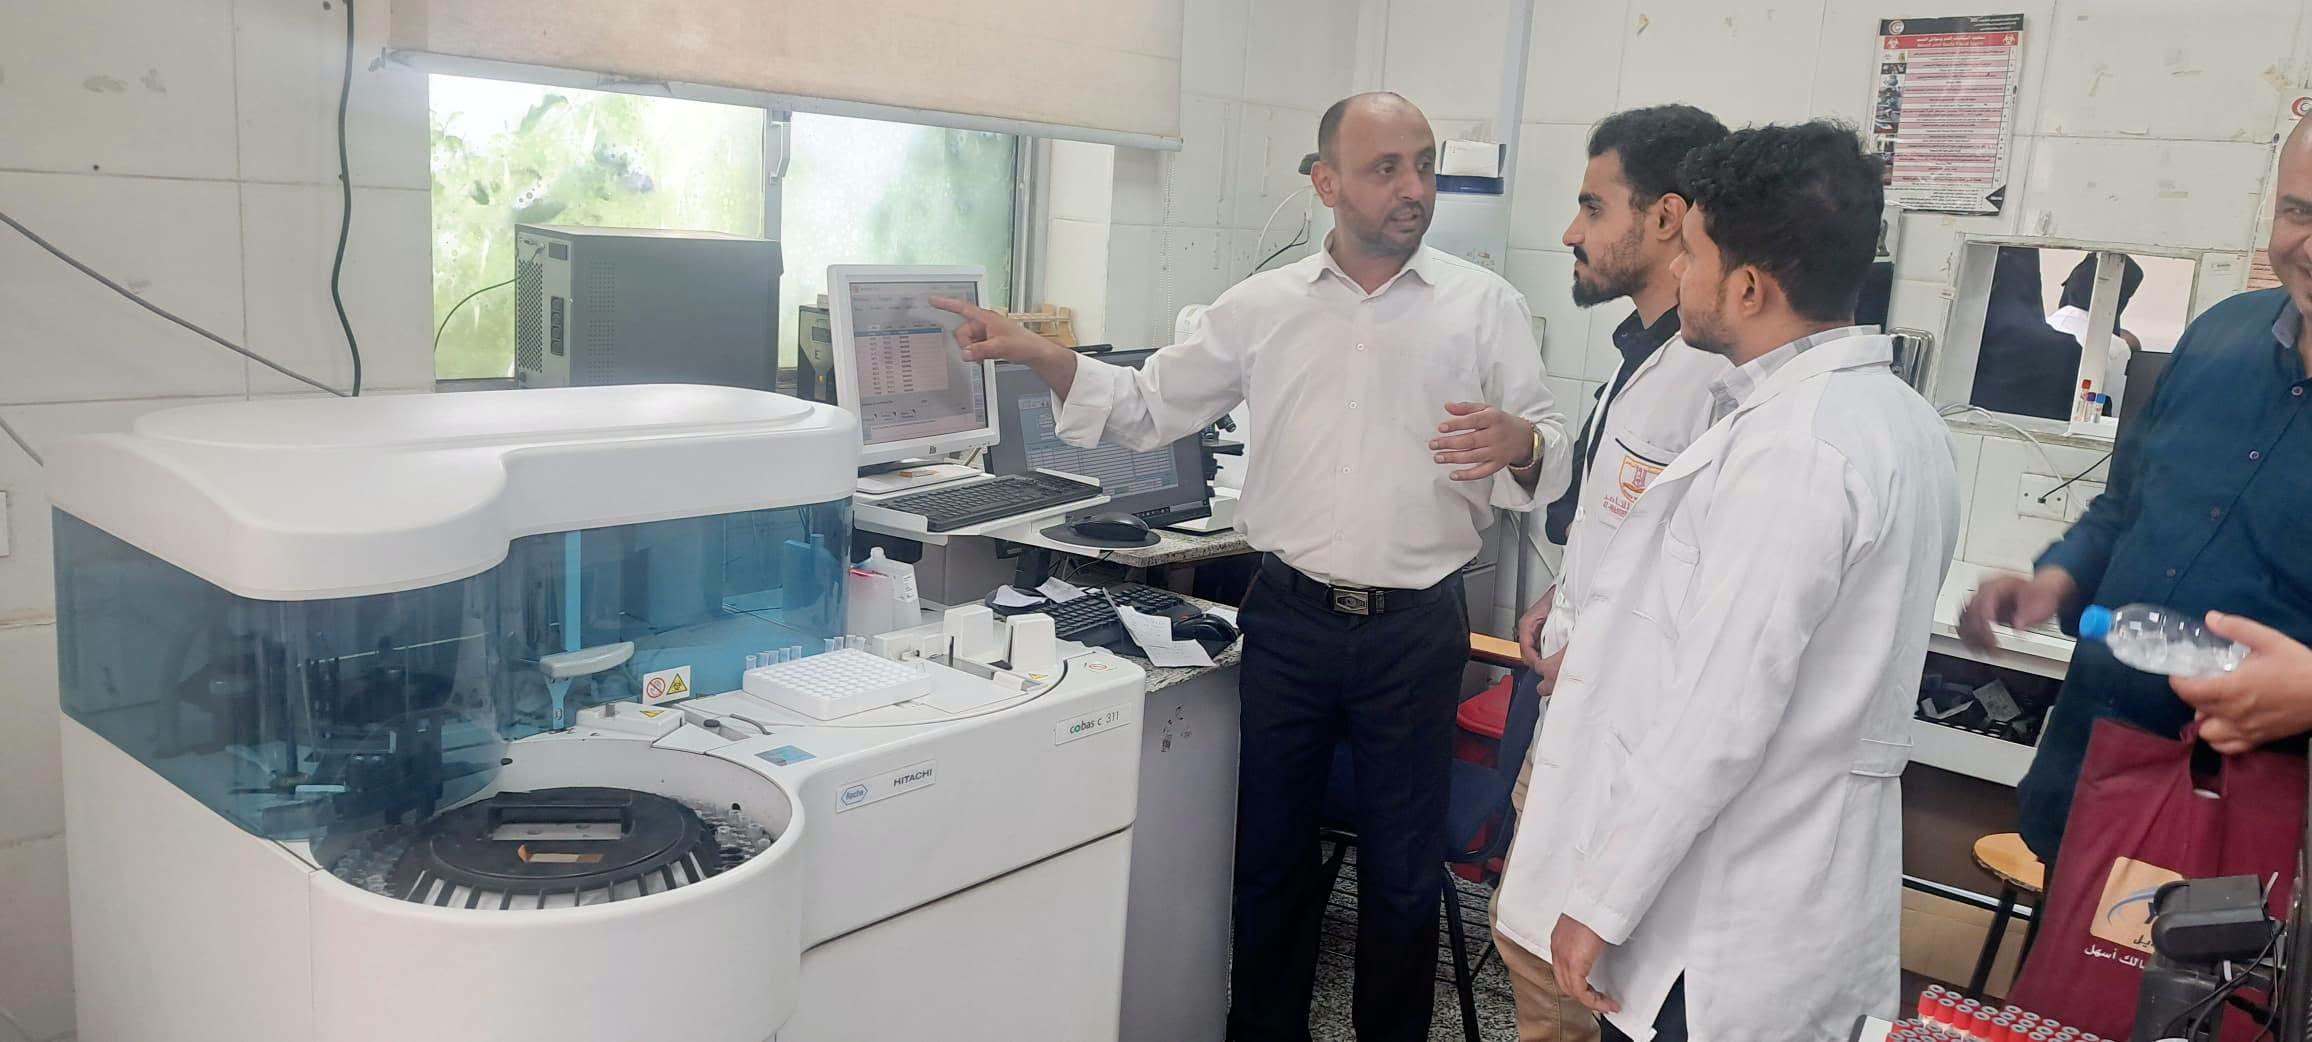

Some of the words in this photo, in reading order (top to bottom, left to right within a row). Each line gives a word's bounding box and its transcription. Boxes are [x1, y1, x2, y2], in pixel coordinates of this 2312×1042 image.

[1069, 720, 1095, 734] cobas
[1105, 711, 1120, 724] 311
[893, 768, 933, 787] HITACHI
[2084, 943, 2117, 960] أسهل
